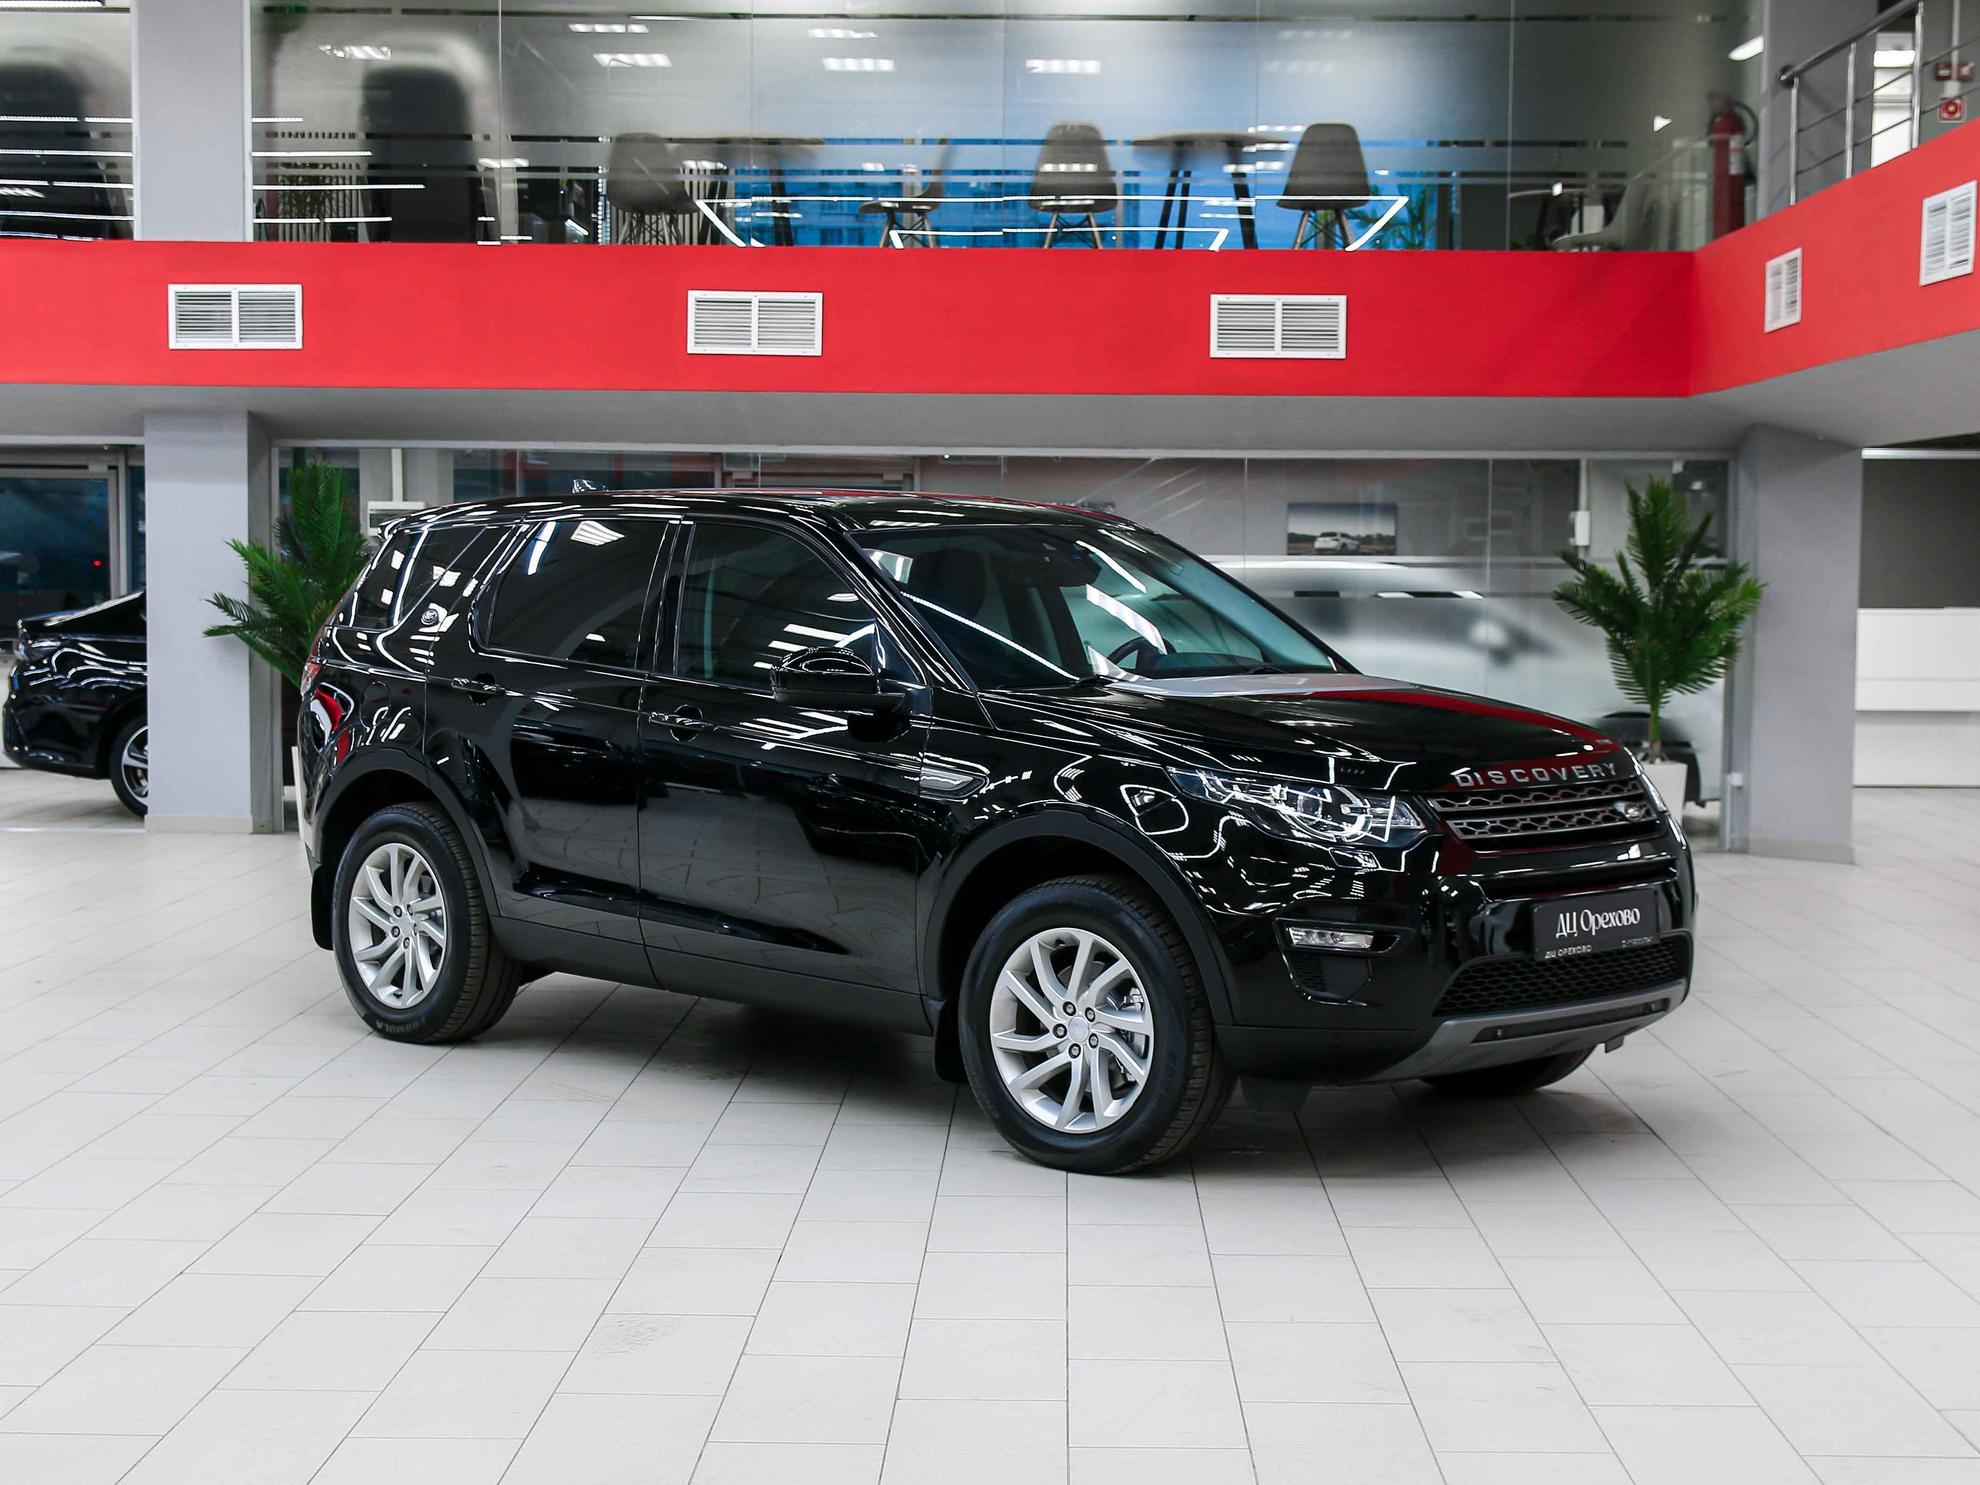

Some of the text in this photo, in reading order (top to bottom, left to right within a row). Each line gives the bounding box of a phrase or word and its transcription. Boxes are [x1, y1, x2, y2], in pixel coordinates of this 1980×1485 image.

[1453, 763, 1617, 787] DISCOVERY
[1556, 908, 1640, 938] ДЦ Орехово
